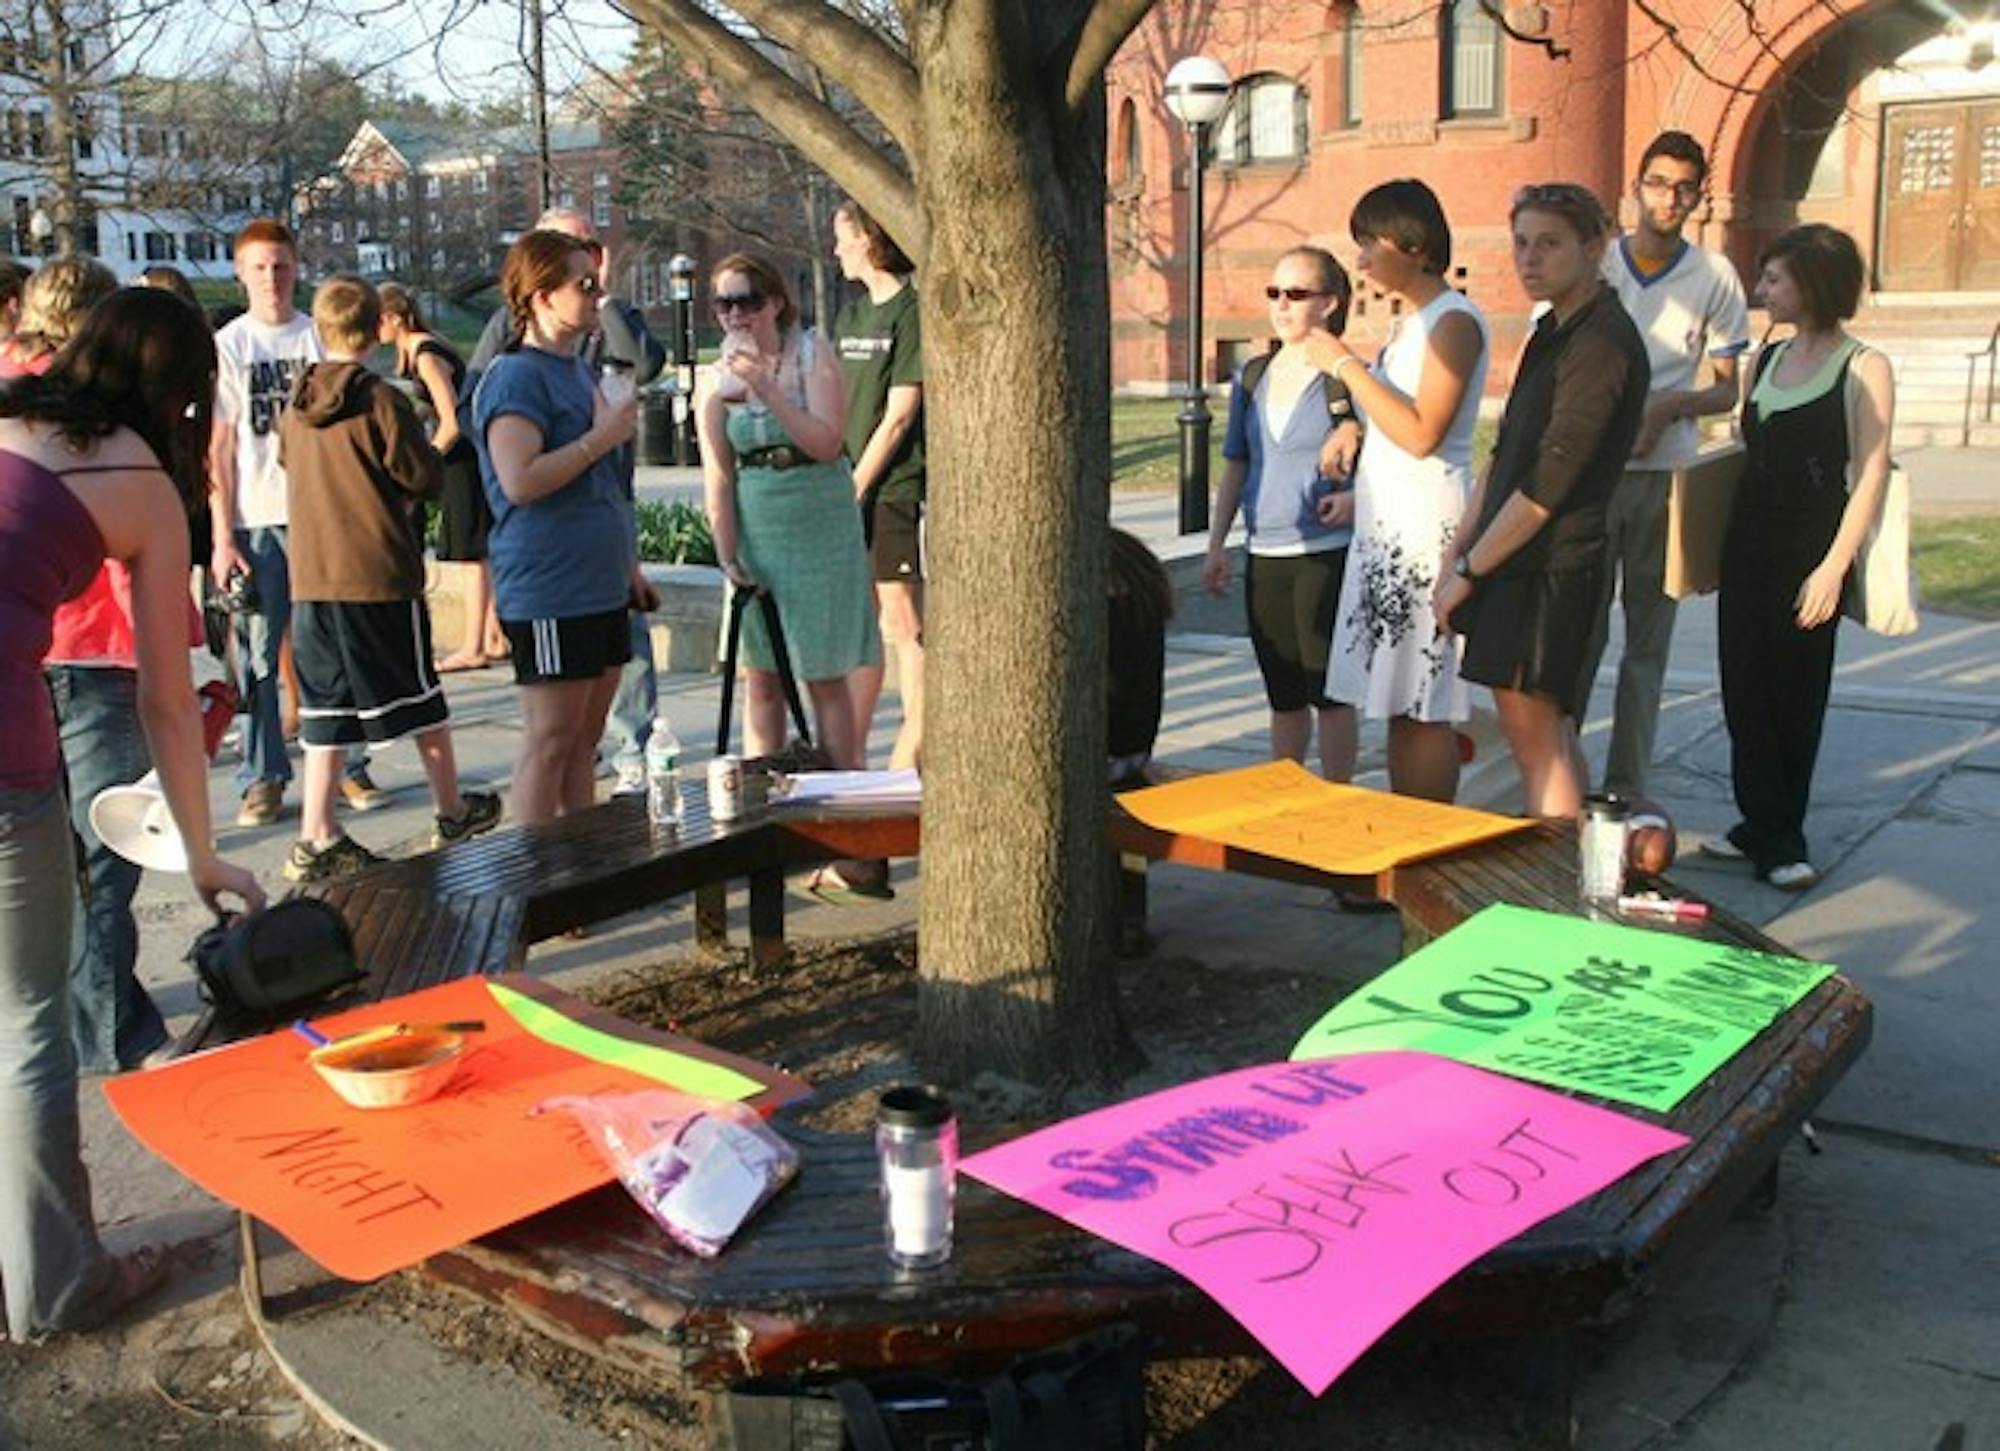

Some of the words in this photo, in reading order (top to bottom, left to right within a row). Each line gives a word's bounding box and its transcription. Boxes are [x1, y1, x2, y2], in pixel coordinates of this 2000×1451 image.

[1327, 966, 1554, 1037] YOU
[1563, 955, 1652, 999] ARE
[234, 1126, 444, 1225] NIGHT
[1048, 1105, 1308, 1202] STAND
[1250, 1064, 1367, 1106] UP
[1168, 1148, 1412, 1284] SPEAK
[1442, 1117, 1579, 1206] OUT
